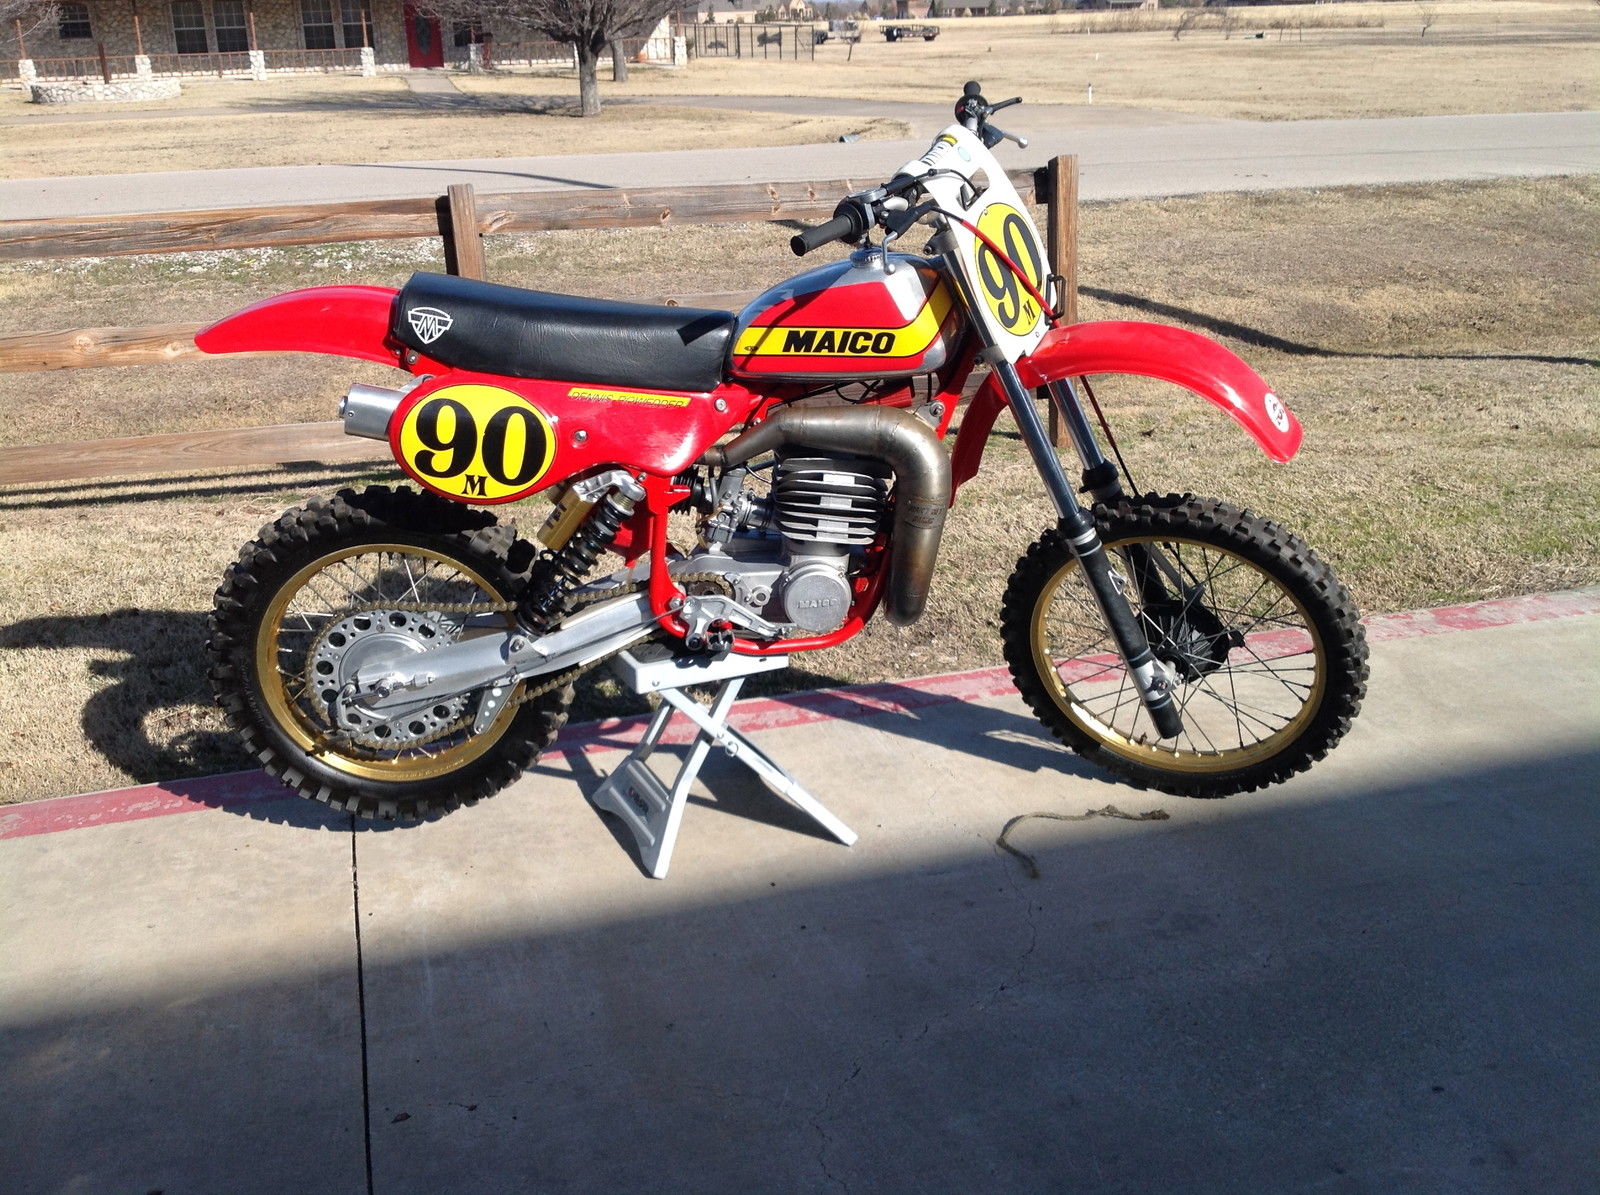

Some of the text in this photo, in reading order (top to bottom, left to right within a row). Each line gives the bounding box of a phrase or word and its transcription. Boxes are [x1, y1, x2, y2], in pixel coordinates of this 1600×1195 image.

[978, 213, 1042, 329] 90
[1023, 300, 1036, 326] M
[782, 330, 895, 354] MAICO
[414, 398, 547, 487] 90
[461, 474, 487, 497] M
